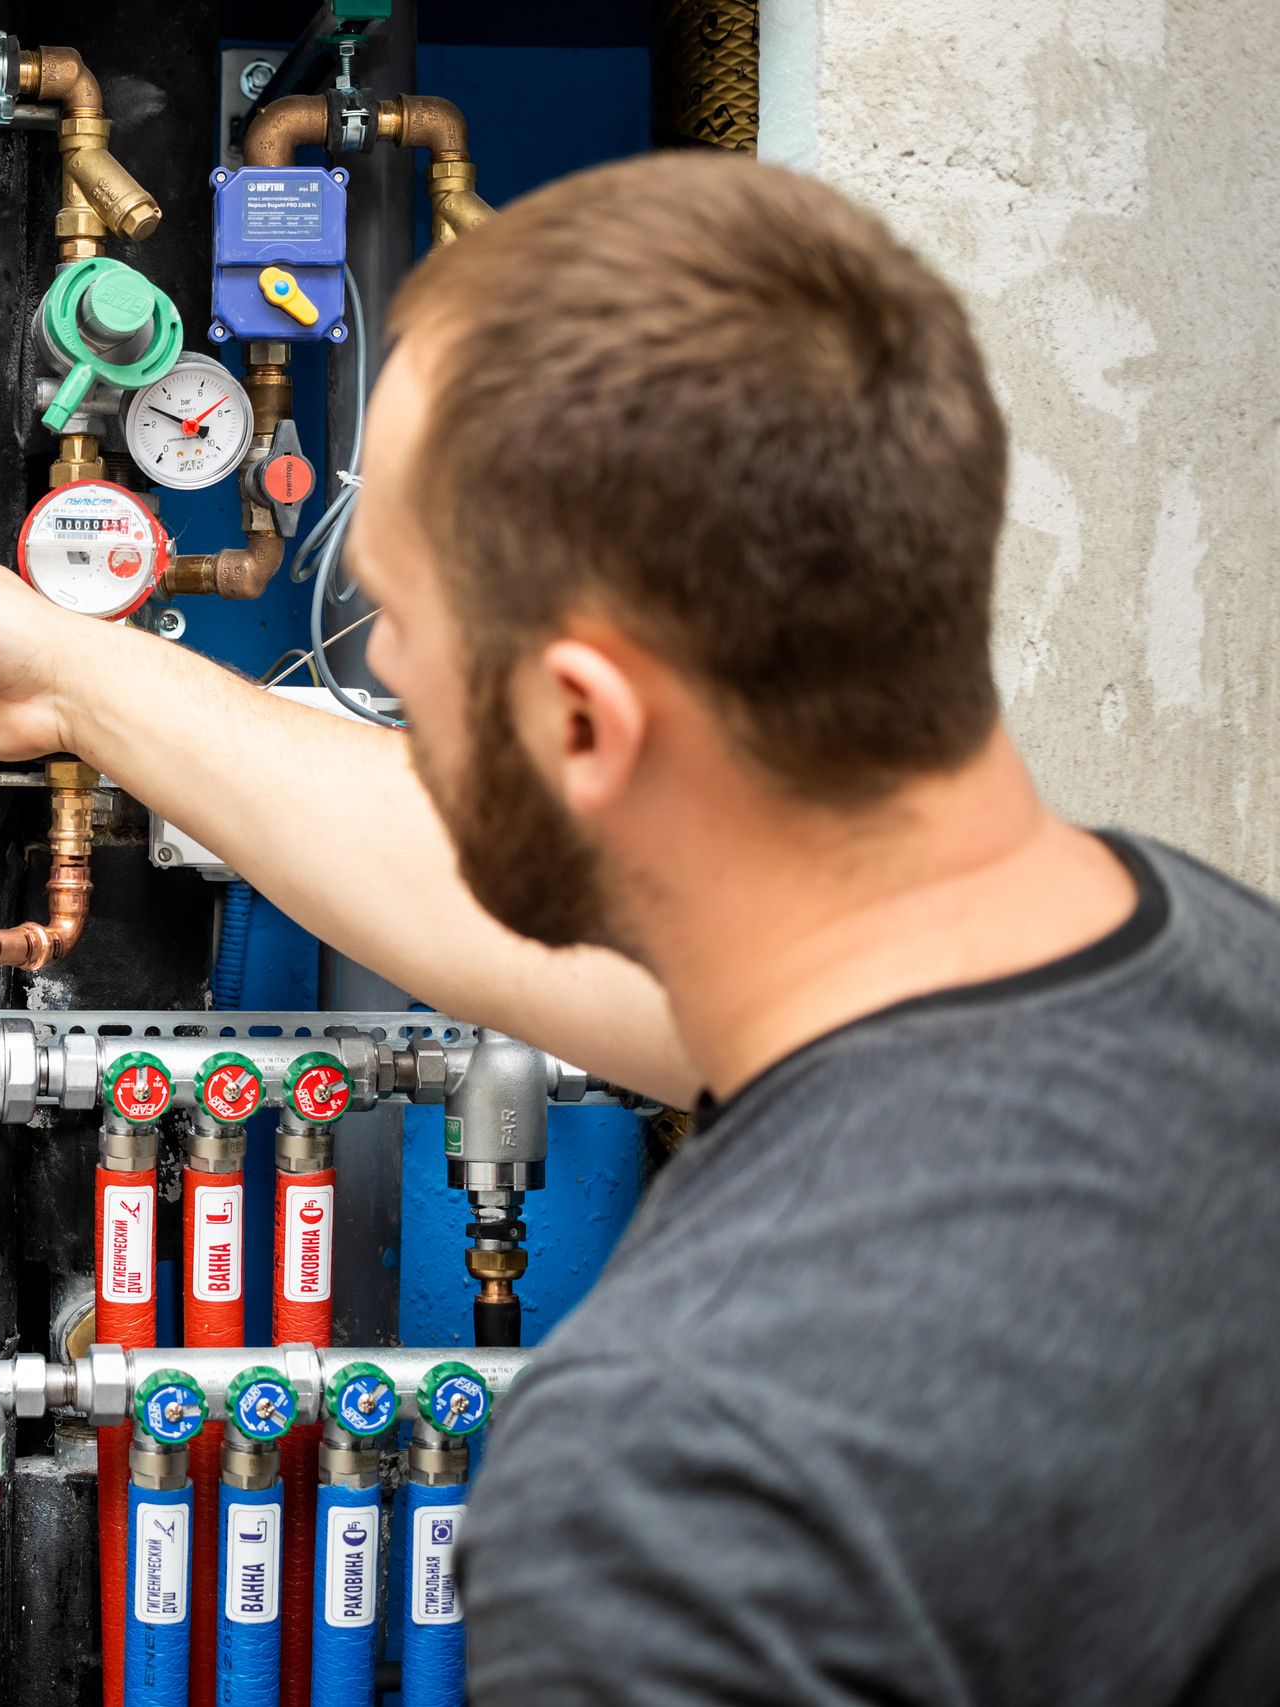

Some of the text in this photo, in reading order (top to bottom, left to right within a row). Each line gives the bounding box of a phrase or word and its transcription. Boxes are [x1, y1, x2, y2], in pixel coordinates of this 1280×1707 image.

[257, 183, 284, 192] NEPTUN
[177, 459, 204, 472] FAR
[64, 498, 112, 506] ПУЛЬСАР
[129, 1104, 155, 1116] FAR
[208, 1096, 234, 1117] FAR
[296, 1089, 314, 1112] FAR
[502, 1109, 516, 1147] FAR
[112, 1220, 128, 1293] ГИГИЕНИЧЕСКИЙ
[208, 1243, 231, 1291] ВАННА
[300, 1229, 320, 1293] РАКОВИНА
[128, 1272, 142, 1293] ДУШ
[240, 1384, 261, 1412] FAR
[454, 1376, 482, 1397] FAR
[148, 1402, 163, 1428] FAR
[341, 1406, 367, 1429] FAR
[146, 1539, 162, 1614] ГИГИЕНИЧЕСКИЙ
[241, 1563, 265, 1612] ВАННА
[344, 1551, 364, 1617] РАКОВИНА
[425, 1556, 440, 1614] СТИРАЛЬНАЯ
[162, 1592, 178, 1614] ДУШ
